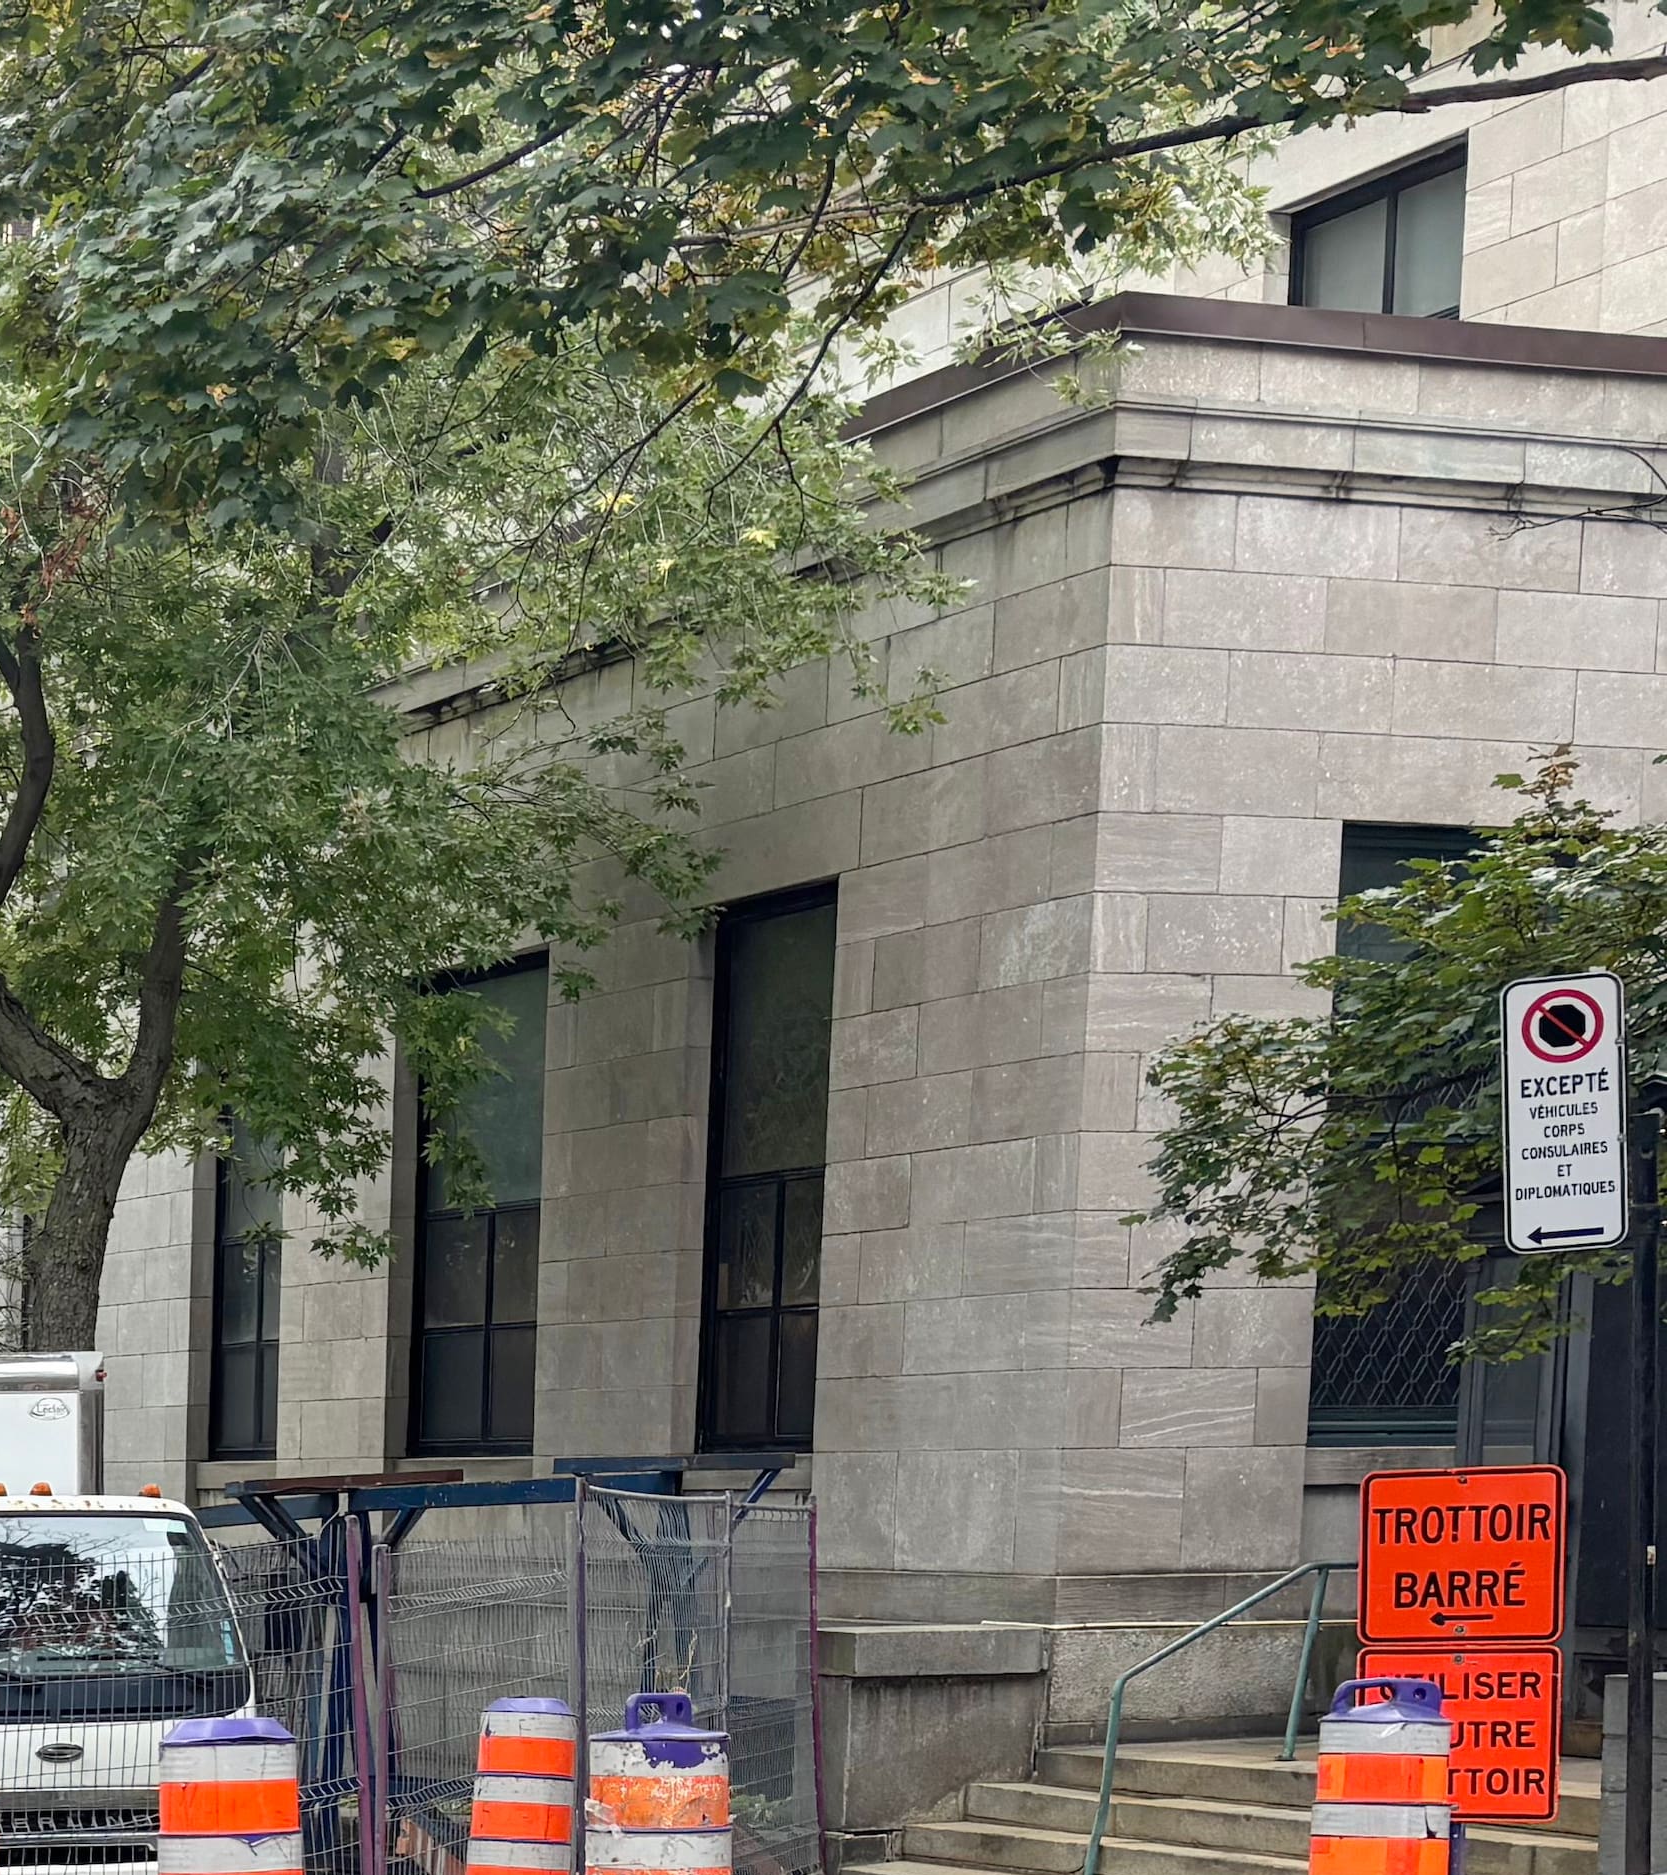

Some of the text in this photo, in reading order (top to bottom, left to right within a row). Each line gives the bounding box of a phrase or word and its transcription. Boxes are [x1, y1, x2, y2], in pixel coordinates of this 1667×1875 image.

[1520, 1067, 1610, 1099] EXCEPTÉ
[1529, 1101, 1599, 1120] VÉHICULES
[1543, 1122, 1586, 1139] CORPS
[1521, 1140, 1609, 1161] CONSULAIRES
[1557, 1163, 1573, 1178] ET
[1515, 1180, 1616, 1201] DIPLOMATIQUES
[1372, 1503, 1552, 1545] TROTTOIR
[1394, 1561, 1526, 1609] BARRÉ
[1379, 1671, 1541, 1700] ULISER
[1449, 1720, 1537, 1749] UTRE
[1447, 1768, 1545, 1796] TTOIR
